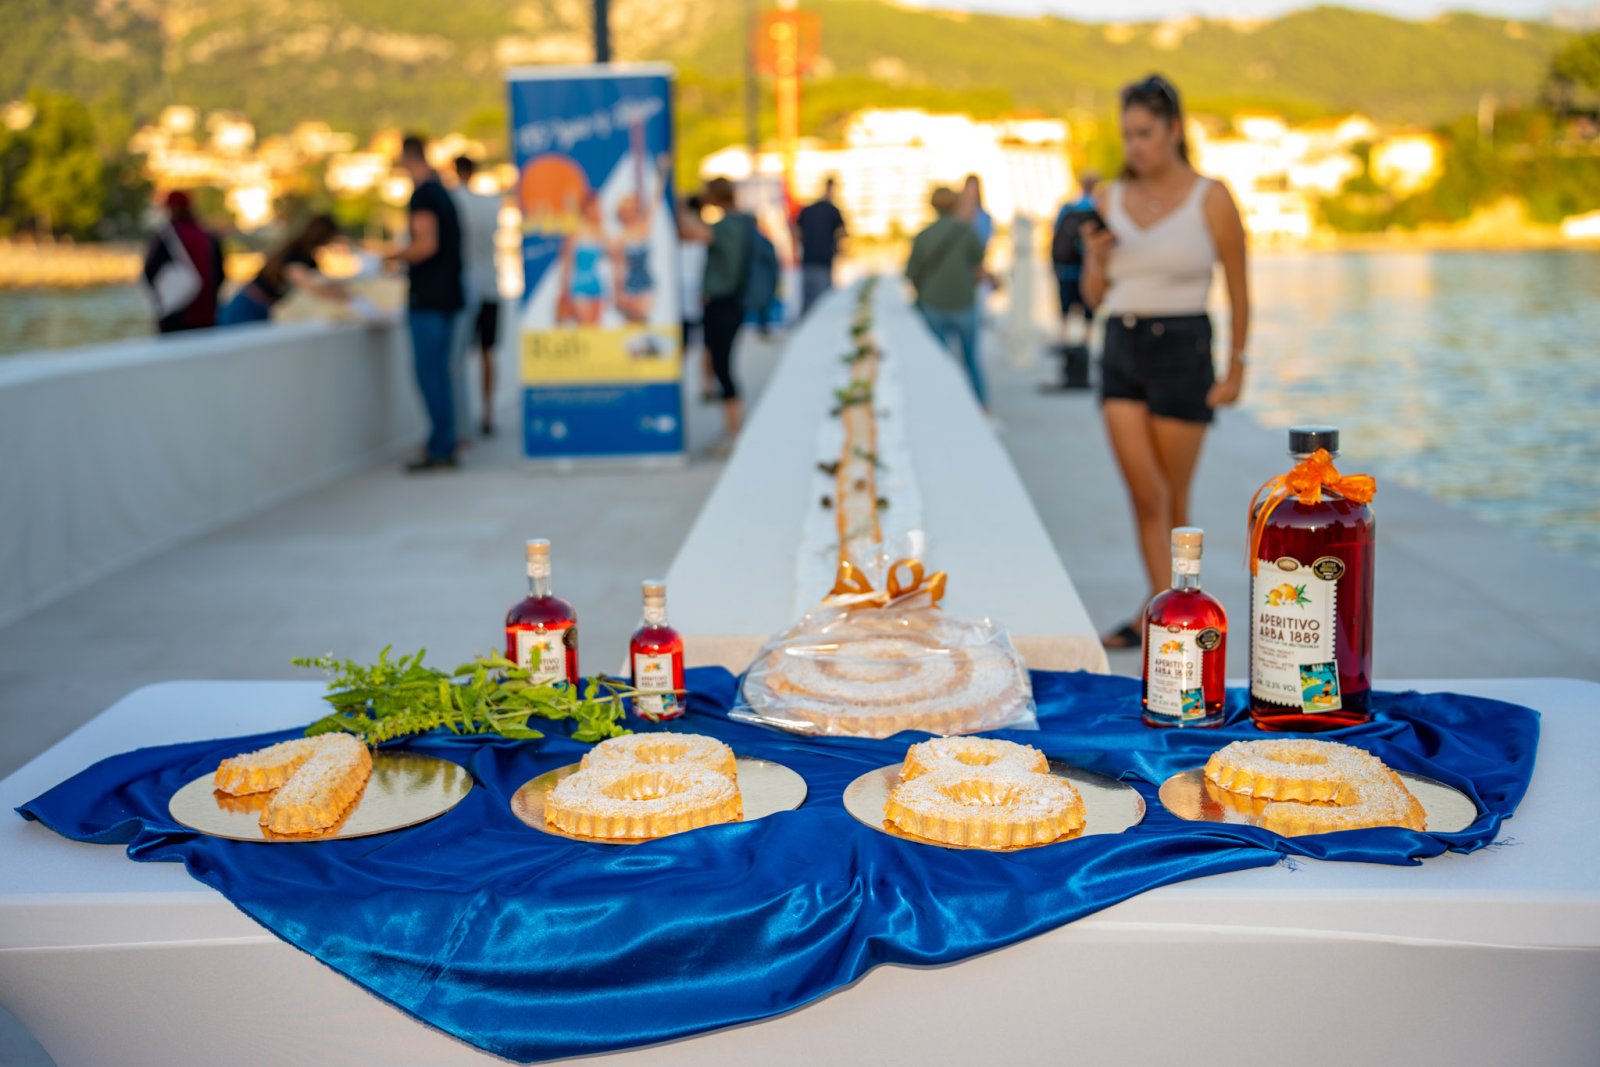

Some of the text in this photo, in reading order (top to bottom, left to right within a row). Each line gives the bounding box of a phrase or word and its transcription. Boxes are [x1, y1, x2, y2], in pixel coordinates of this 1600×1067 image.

[1260, 613, 1320, 631] APERITIVO
[1260, 626, 1284, 640] ARBA
[1290, 630, 1320, 644] 1889
